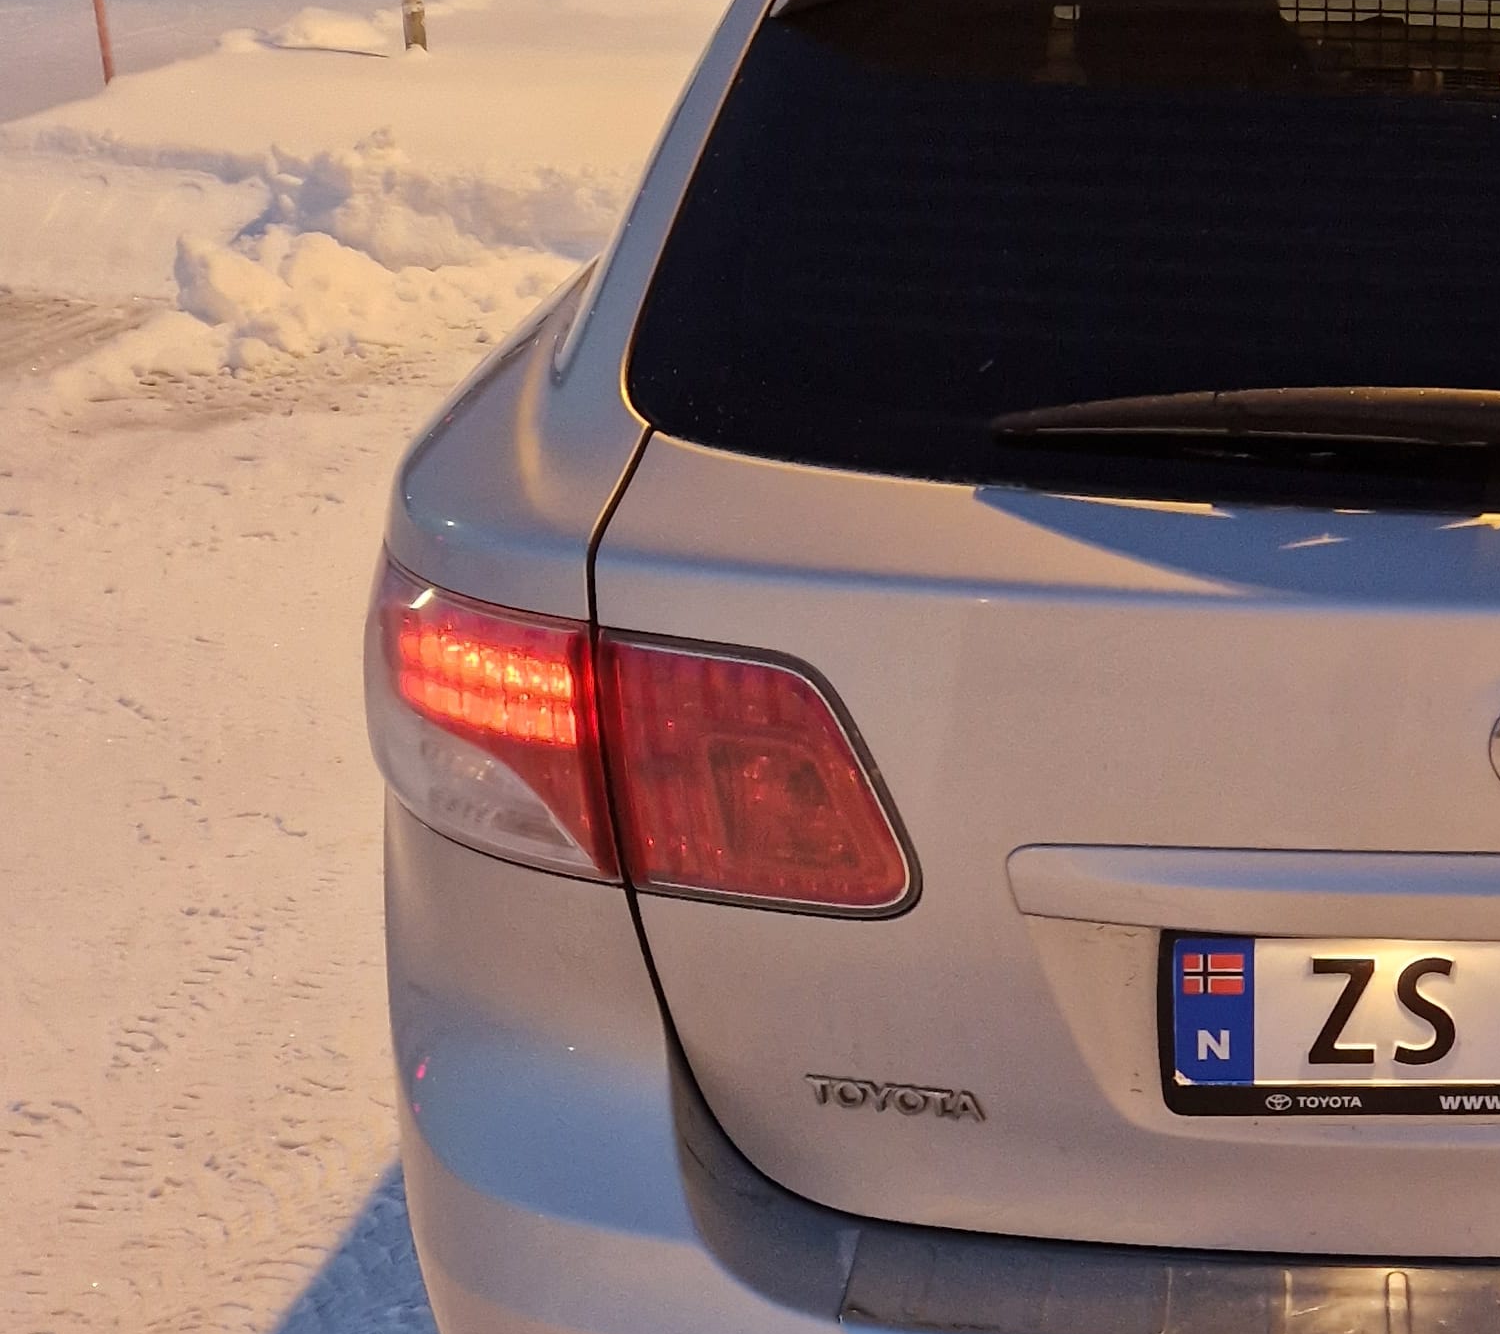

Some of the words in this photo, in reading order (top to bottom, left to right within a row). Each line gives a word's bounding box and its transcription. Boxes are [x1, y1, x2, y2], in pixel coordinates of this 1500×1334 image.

[1307, 956, 1457, 1065] ZS
[1196, 1029, 1231, 1061] N
[805, 1074, 987, 1122] TOYOTA
[1296, 1095, 1362, 1109] TOYOTA
